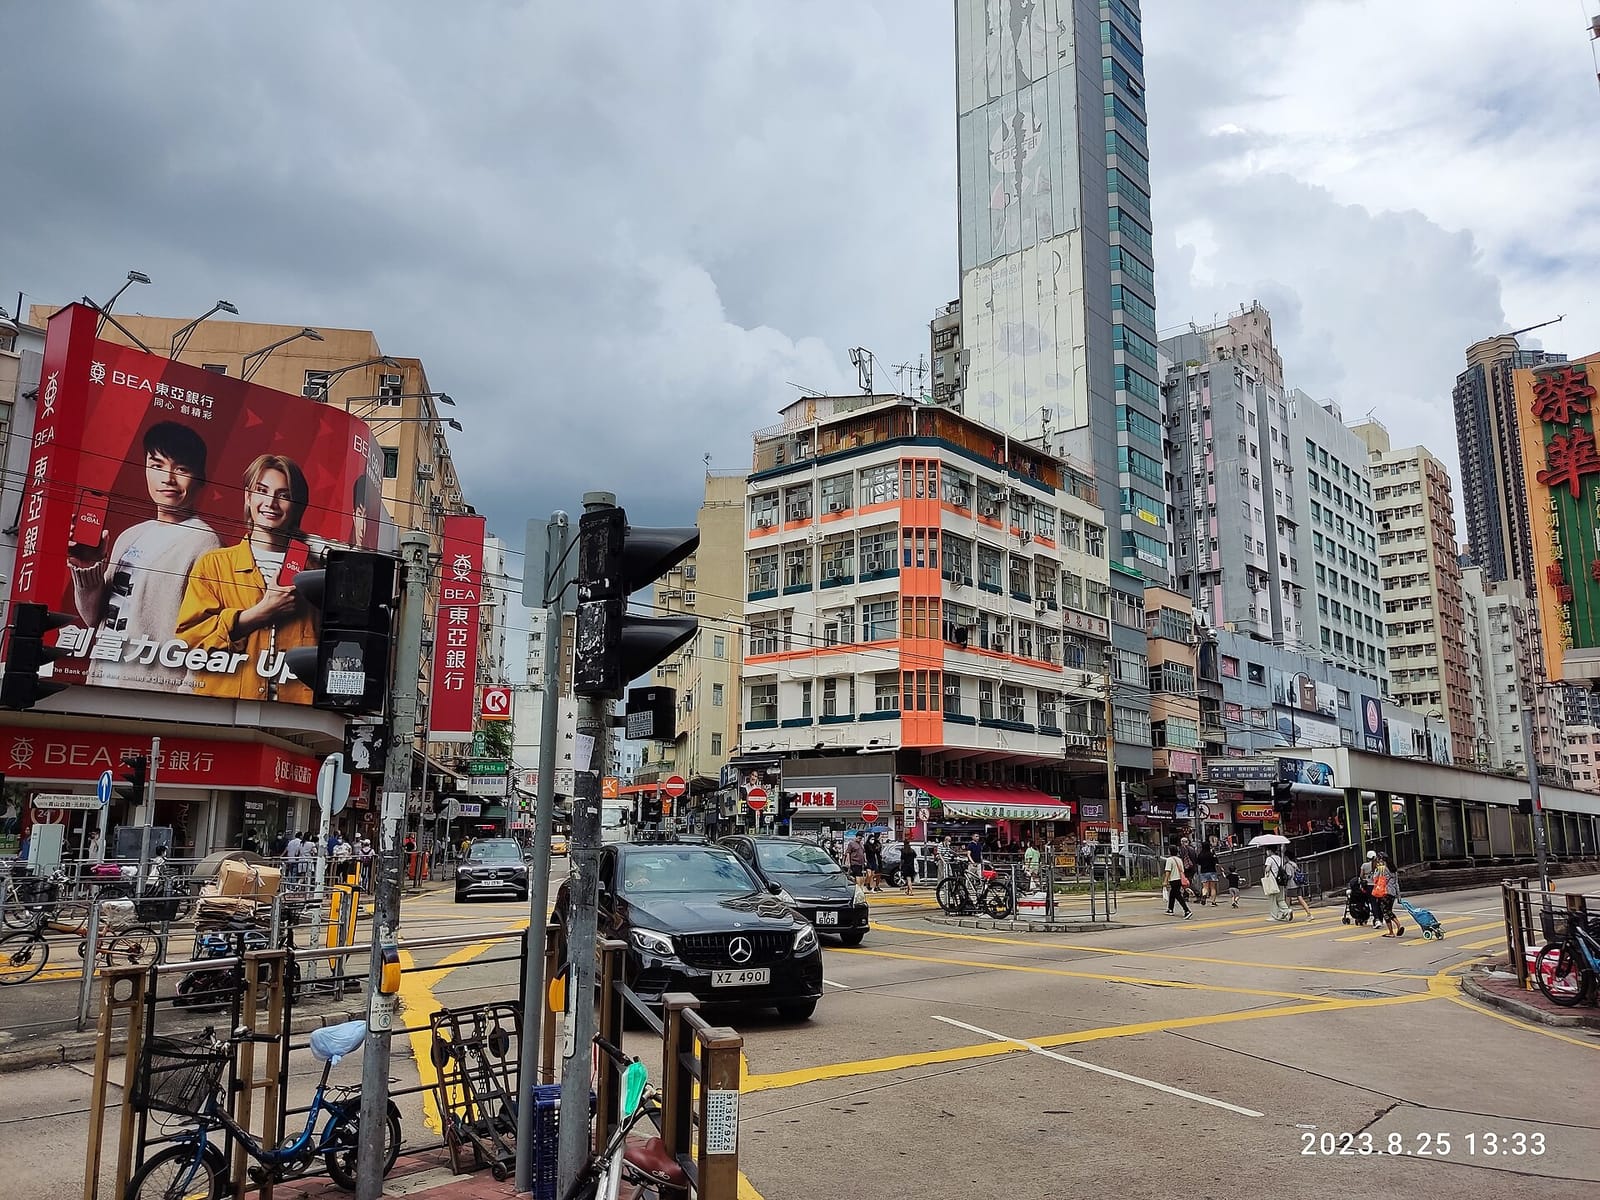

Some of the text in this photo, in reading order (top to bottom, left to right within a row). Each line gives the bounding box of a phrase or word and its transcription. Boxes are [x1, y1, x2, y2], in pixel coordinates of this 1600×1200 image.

[111, 370, 153, 393] BEA
[155, 382, 214, 409] 東亞銀行
[153, 397, 213, 420] 同心 創精彩
[34, 426, 55, 448] BEA
[1530, 367, 1600, 500] 榮華
[18, 456, 49, 593] 東亞銀行
[80, 515, 101, 526] GOAL
[444, 588, 475, 600] BEA
[443, 606, 469, 690] 東亞銀行
[44, 743, 113, 767] BEA
[118, 747, 214, 772] 東亞銀行
[281, 761, 294, 781] BEA
[792, 791, 835, 807] 中原地產
[716, 970, 766, 984] XZ 4901
[723, 1093, 733, 1151] 91367925
